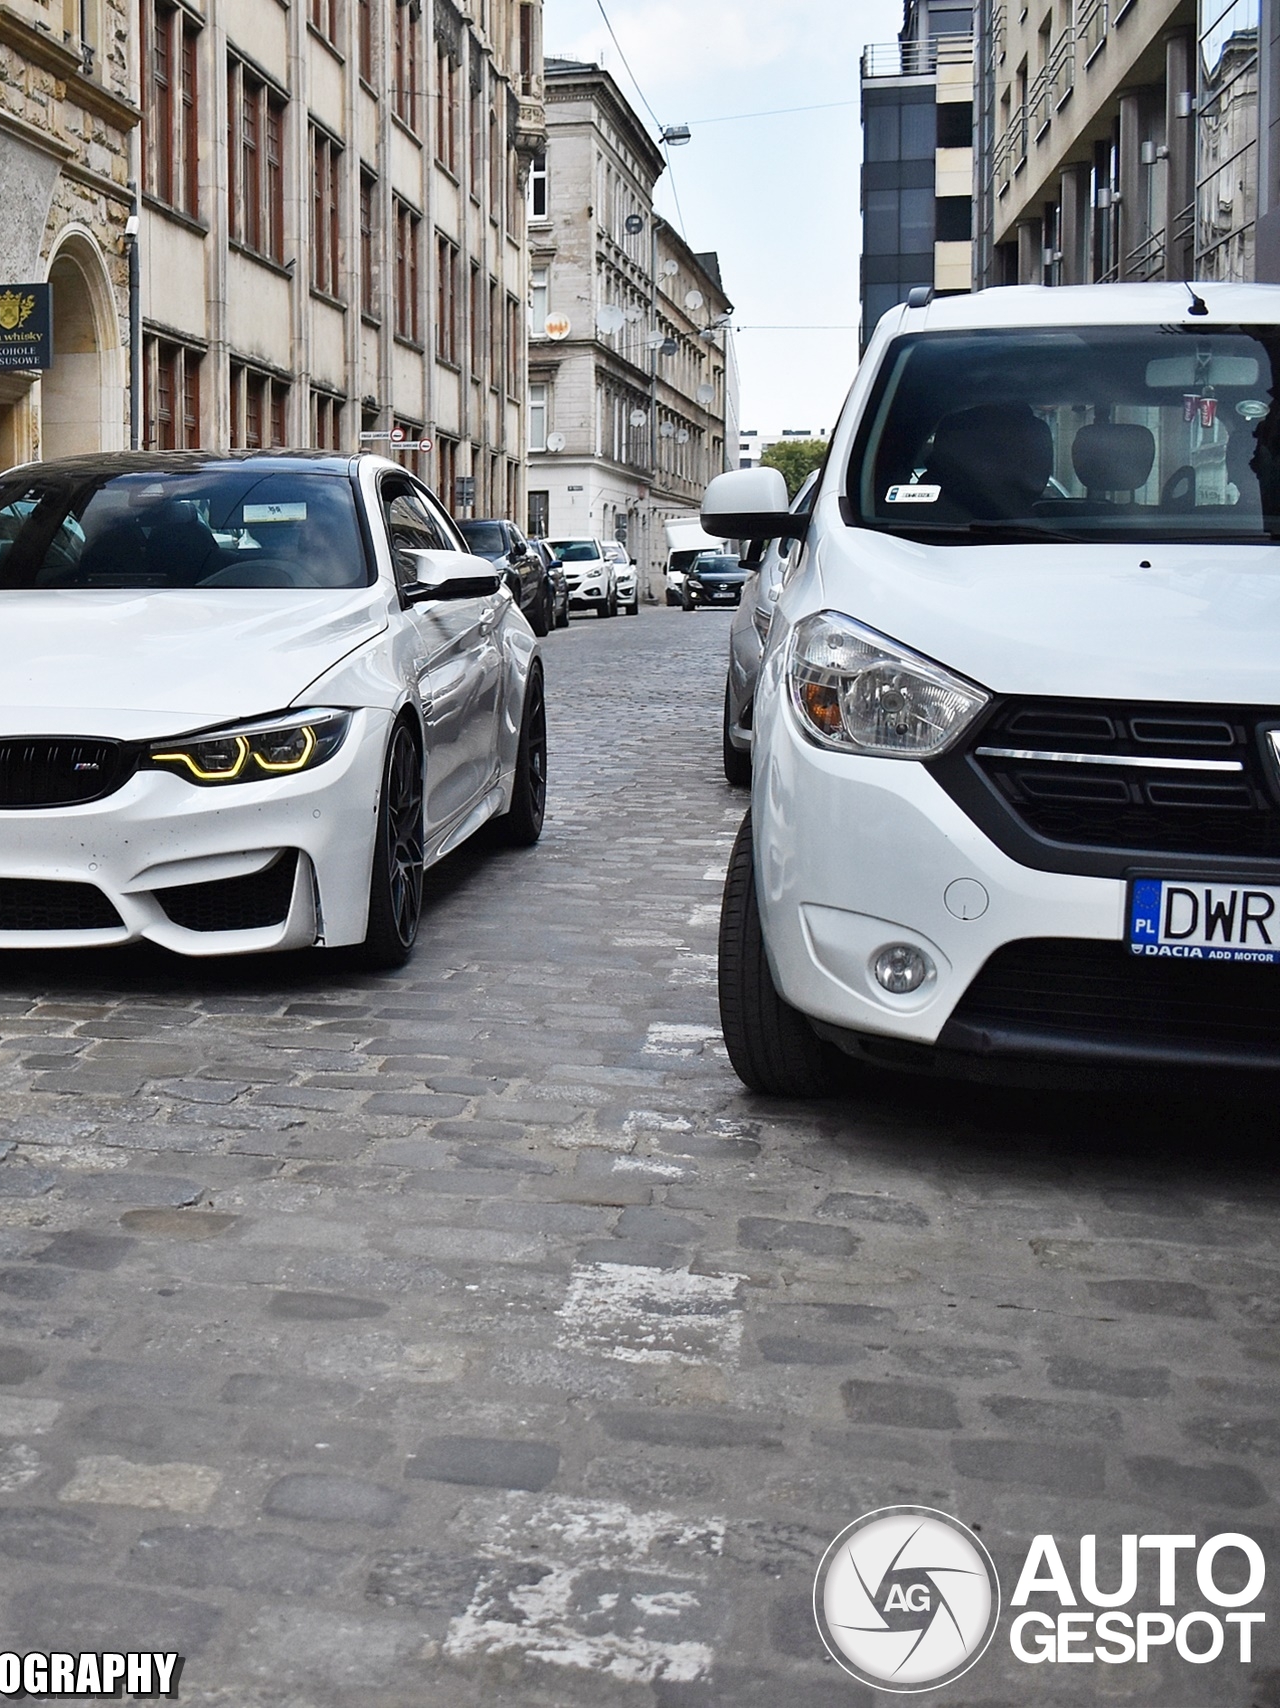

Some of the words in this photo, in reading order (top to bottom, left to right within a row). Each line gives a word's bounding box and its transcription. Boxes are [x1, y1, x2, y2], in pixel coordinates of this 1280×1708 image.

[4, 332, 43, 341] whisky
[1164, 887, 1275, 944] DWR
[1135, 919, 1155, 933] PL
[1145, 944, 1203, 958] DACIA
[1208, 951, 1231, 960] ADD
[1234, 952, 1274, 962] MOTOR
